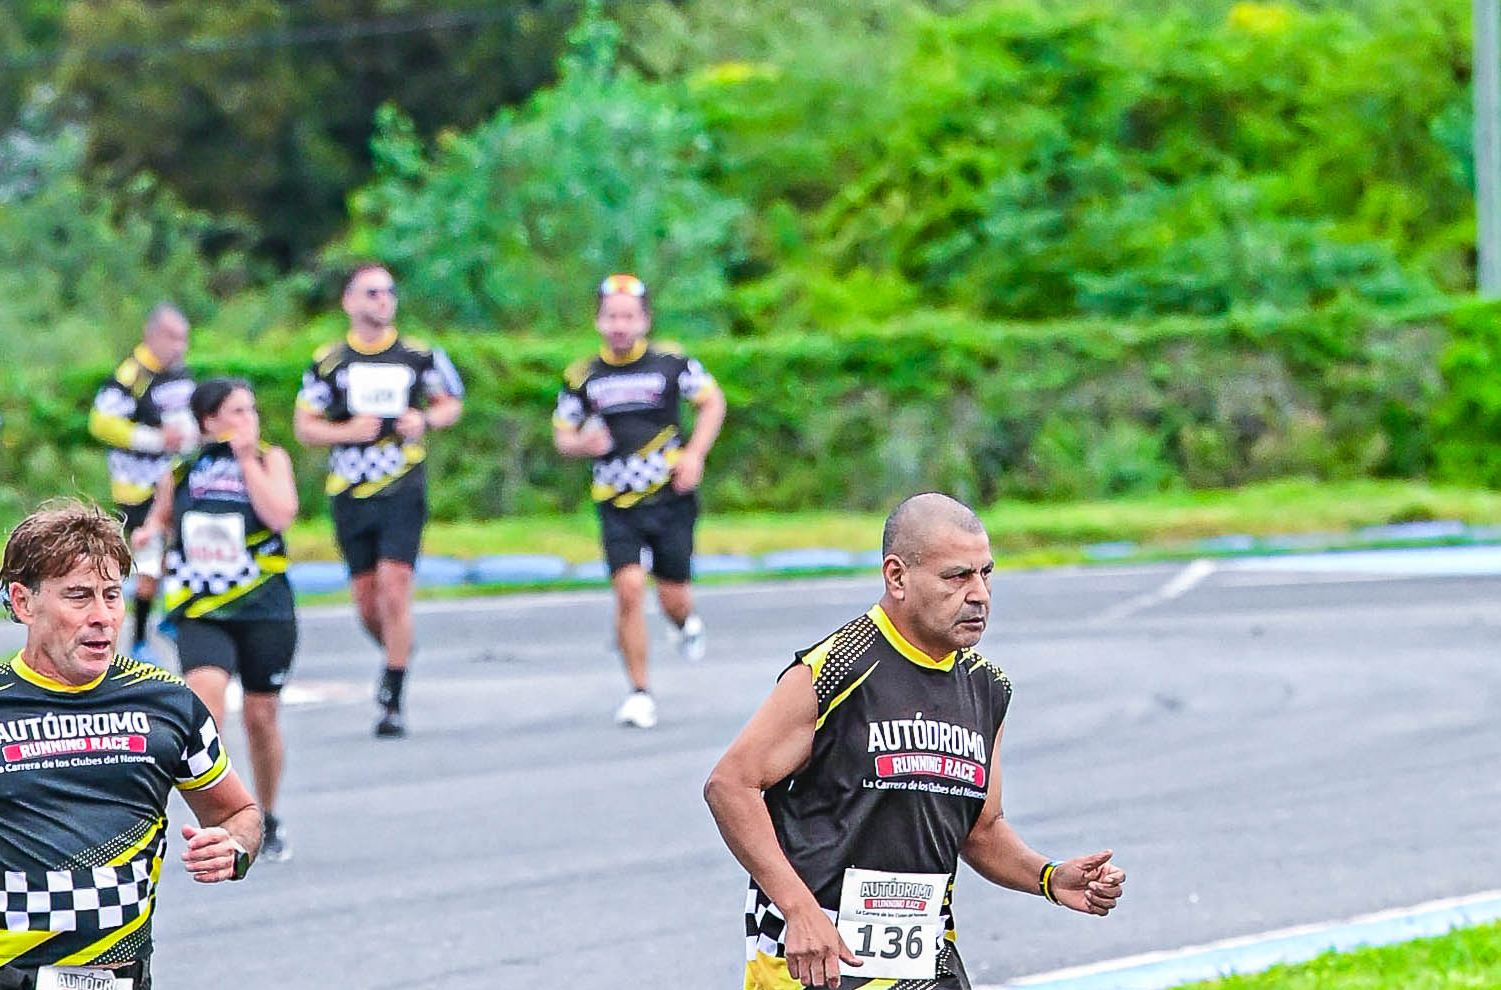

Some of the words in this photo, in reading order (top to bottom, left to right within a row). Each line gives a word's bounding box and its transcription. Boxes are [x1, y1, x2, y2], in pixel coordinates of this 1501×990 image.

[19, 738, 87, 758] RUNNING
[90, 736, 130, 751] RACE
[867, 712, 986, 764] AUTÓDROMO
[5, 761, 40, 773] Carrera
[41, 759, 54, 769] de
[55, 759, 69, 768] los
[71, 756, 102, 767] Clubes
[104, 754, 119, 764] del
[892, 755, 942, 774] RUNNING
[944, 759, 976, 782] RACE
[862, 779, 874, 788] La
[875, 779, 907, 790] Carrera
[908, 780, 917, 790] de
[918, 781, 929, 791] los
[950, 786, 963, 795] del
[860, 877, 934, 900] AUTÓDROMO
[854, 924, 923, 959] 136
